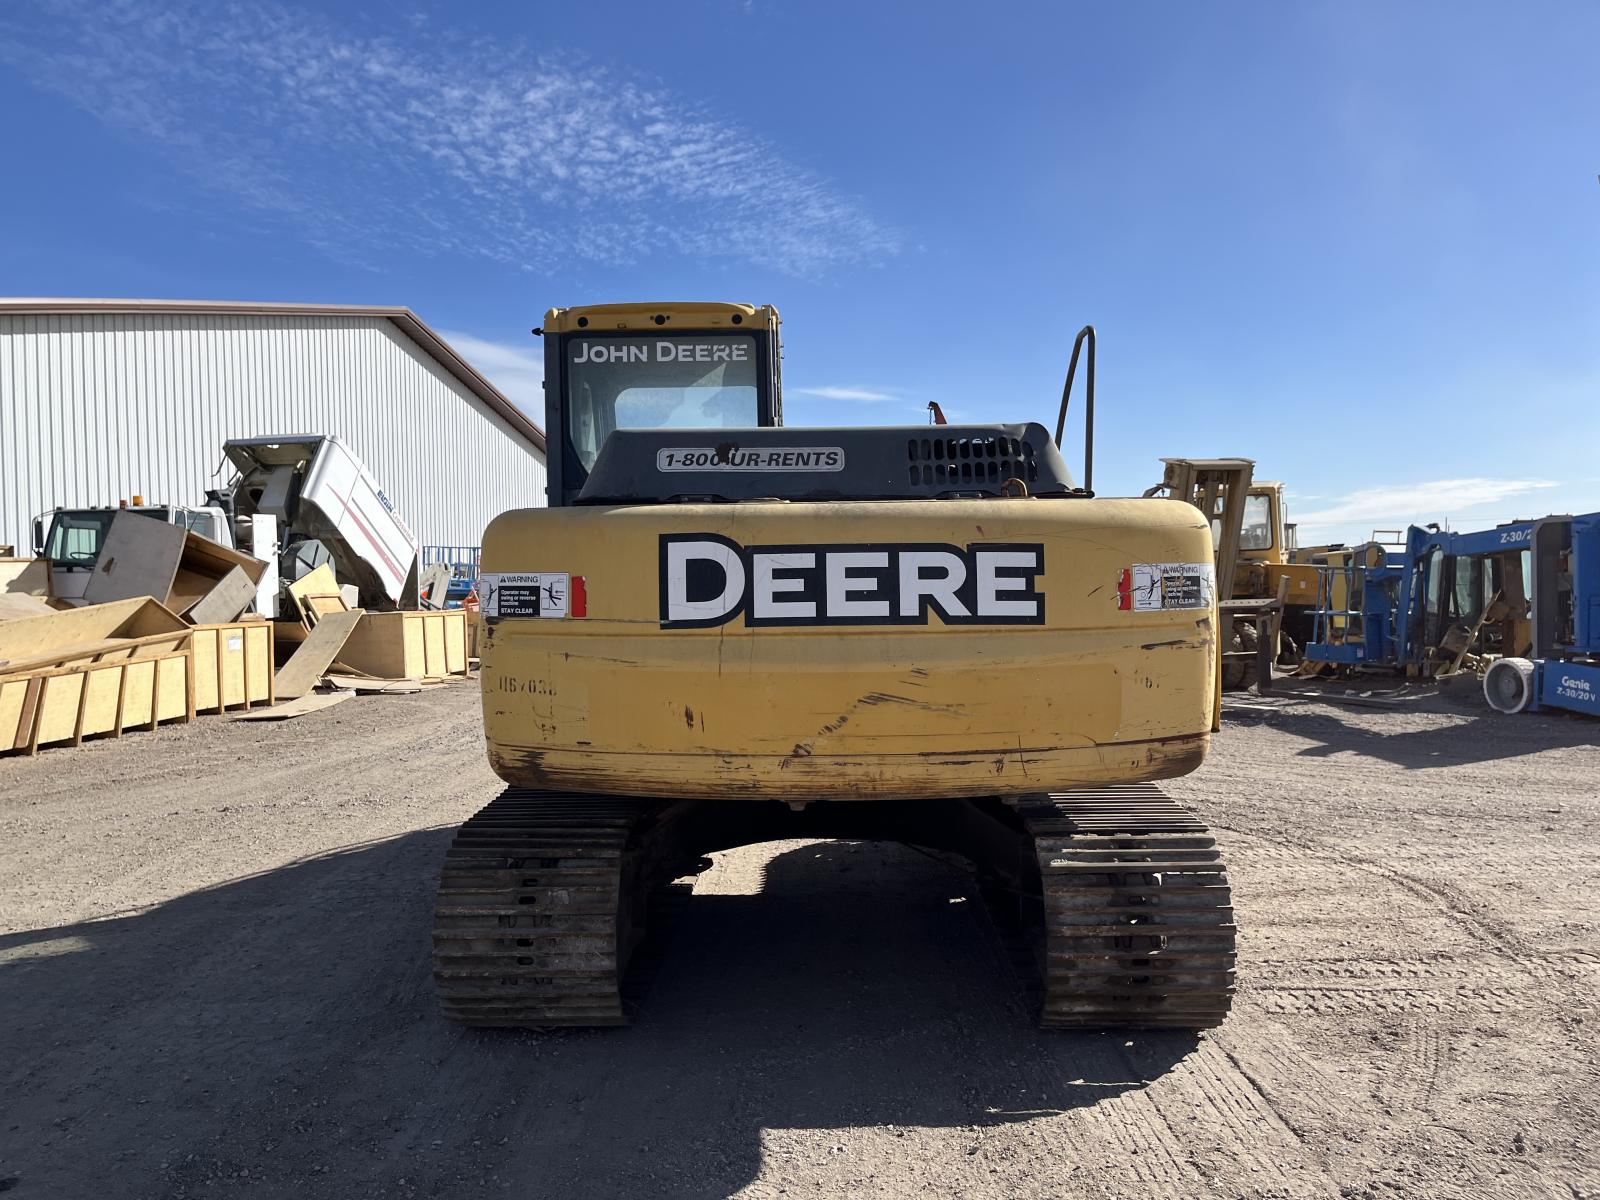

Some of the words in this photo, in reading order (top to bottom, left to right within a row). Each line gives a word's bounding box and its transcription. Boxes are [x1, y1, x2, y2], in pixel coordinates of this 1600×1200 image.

[574, 342, 648, 363] JOHN
[656, 341, 748, 362] DEERE
[665, 451, 839, 467] 1-800UR-RENTS
[667, 540, 1039, 621] DEERE
[1561, 675, 1591, 691] Genie
[1556, 686, 1590, 701] Z-30/20
